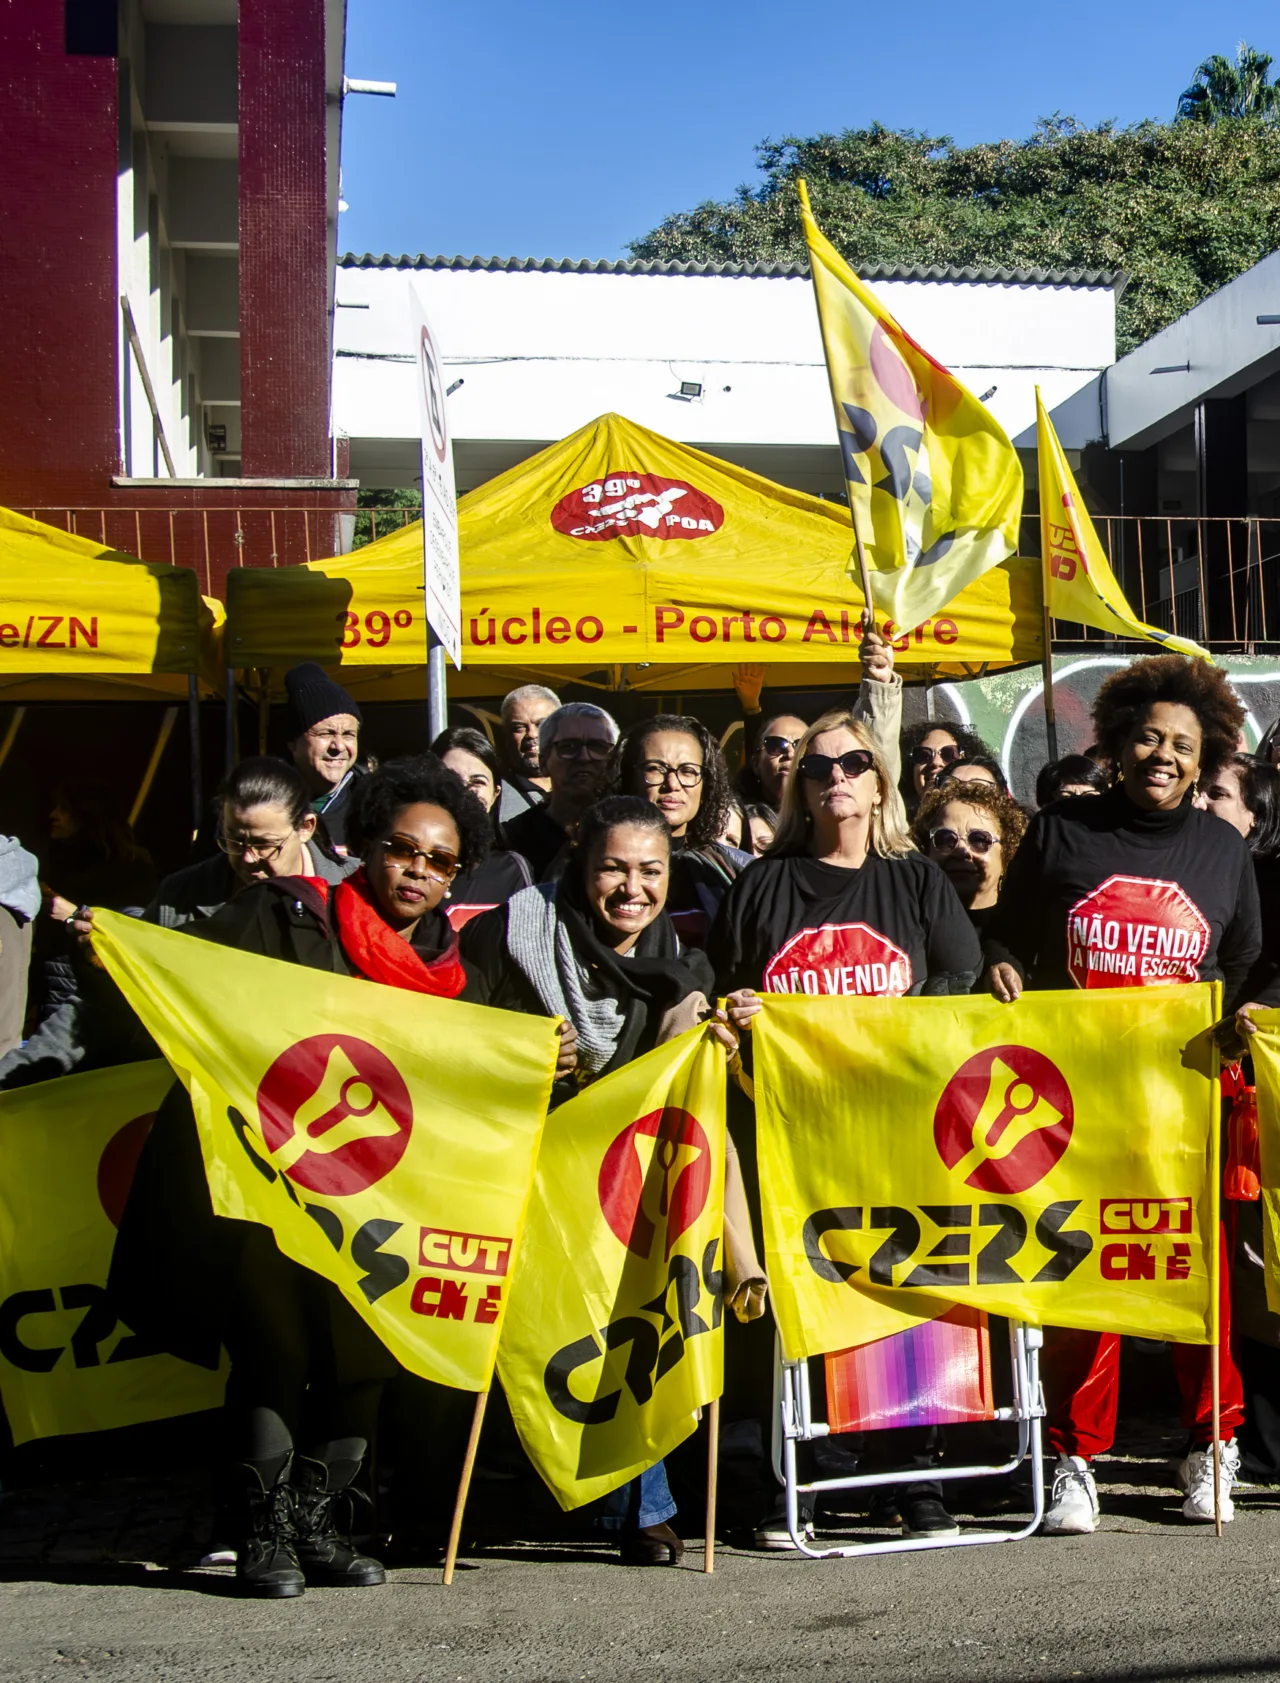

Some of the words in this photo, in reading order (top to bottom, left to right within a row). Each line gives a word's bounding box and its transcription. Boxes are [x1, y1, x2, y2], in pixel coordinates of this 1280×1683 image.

[665, 515, 715, 531] POA
[461, 607, 604, 646] úcleo
[655, 606, 787, 643] Porto
[1073, 913, 1120, 951] NÃO
[1127, 923, 1200, 959] VENDA
[772, 966, 819, 995] NÃO
[823, 961, 903, 995] VENDA
[1074, 948, 1083, 967] A
[1087, 950, 1136, 976] MINHA
[1140, 957, 1194, 977] ESCOLA
[1101, 1200, 1190, 1231] CUT
[421, 1232, 509, 1272] CUT
[802, 1200, 1094, 1288] CPERS
